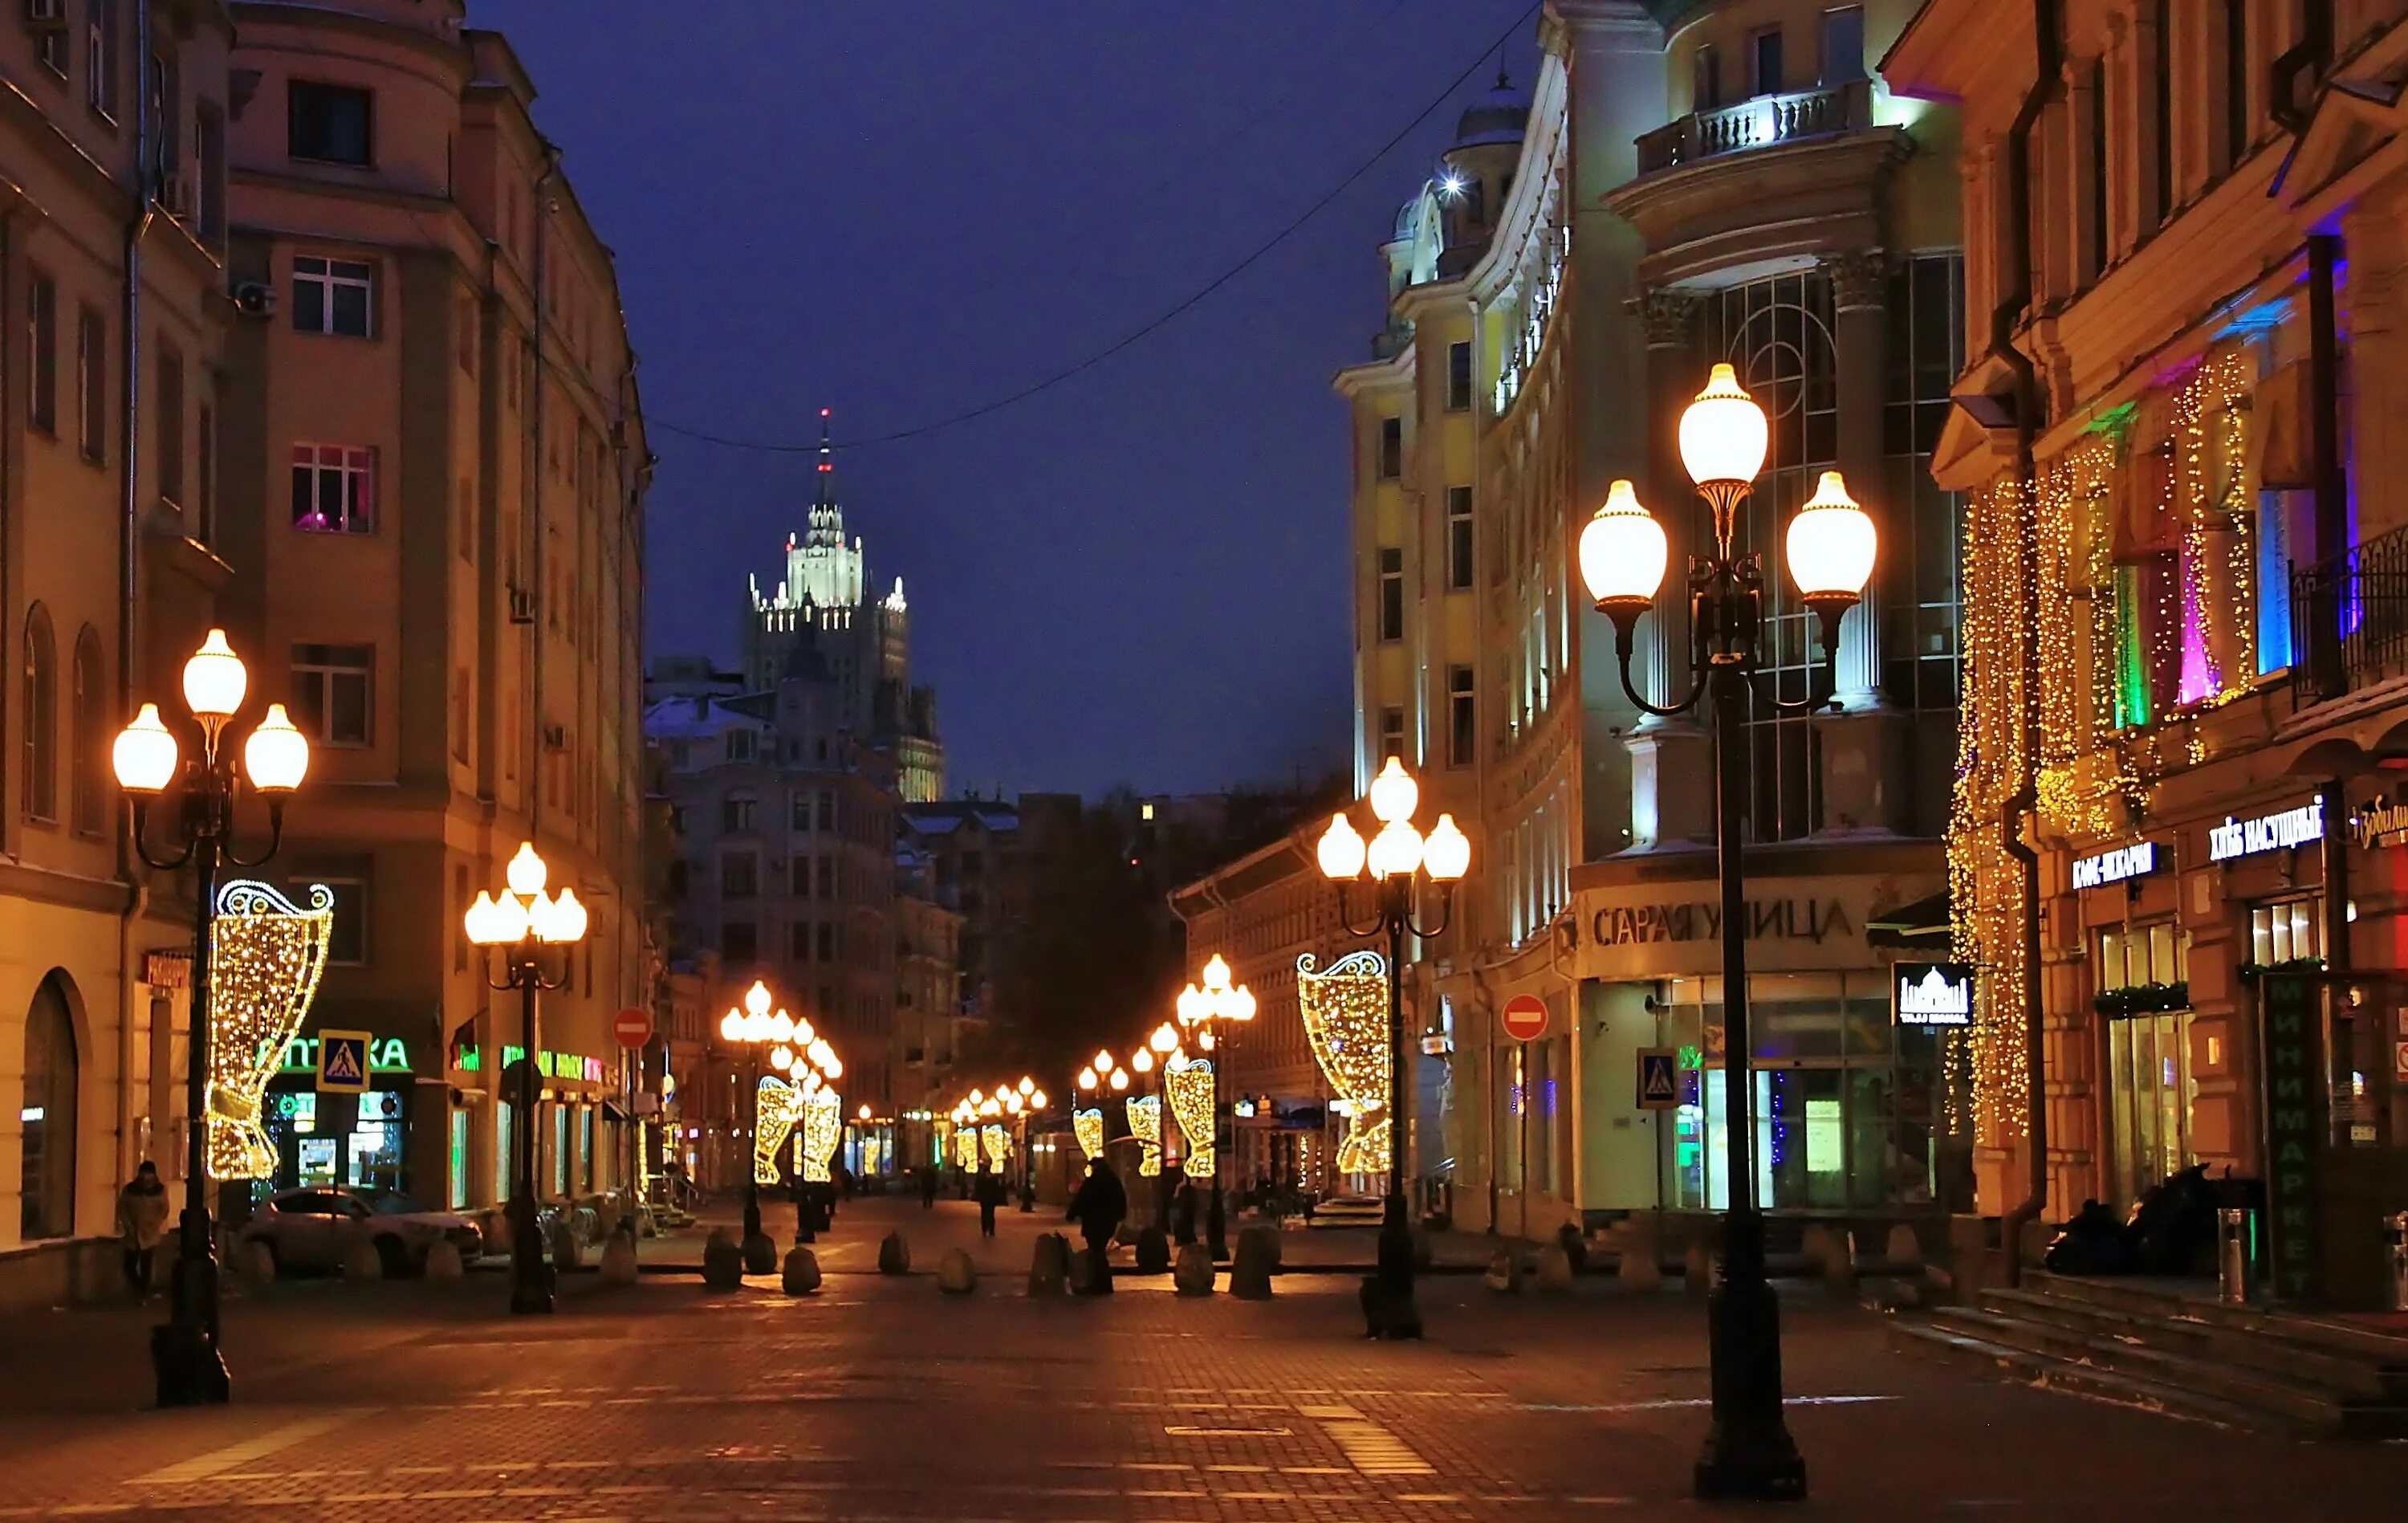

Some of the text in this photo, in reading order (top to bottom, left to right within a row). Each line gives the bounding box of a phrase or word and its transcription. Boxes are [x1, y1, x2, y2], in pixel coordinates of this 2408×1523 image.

[1593, 898, 1853, 946] СТАРАЯ УИЦА
[254, 1037, 409, 1069] АПКА
[2270, 979, 2311, 1292] МИНИМАРКЕТ
